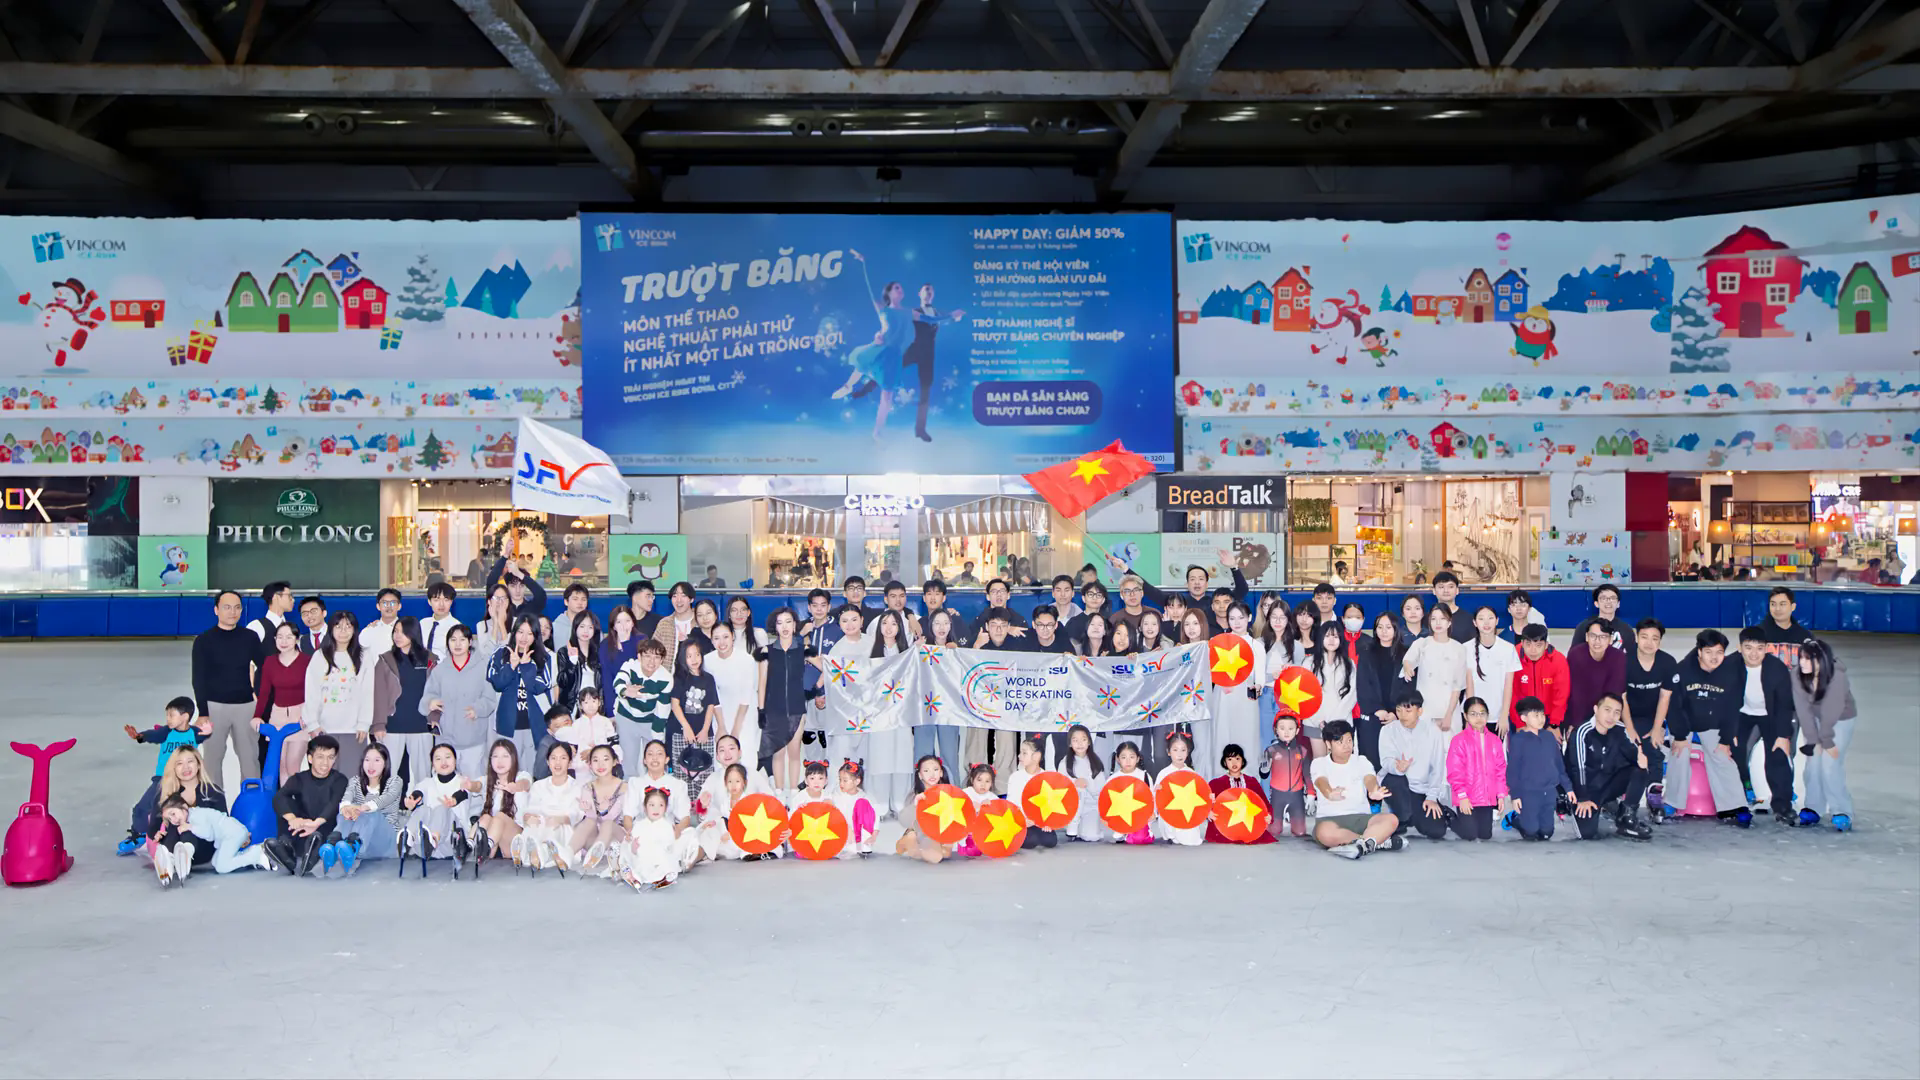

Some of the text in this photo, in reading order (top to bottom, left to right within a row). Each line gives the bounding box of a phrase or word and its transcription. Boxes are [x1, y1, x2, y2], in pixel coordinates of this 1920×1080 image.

[628, 229, 676, 240] VINCOM
[974, 224, 1125, 240] HAPPY DAY: GIẢM 50%
[66, 239, 126, 251] VINCOM
[1215, 240, 1271, 254] VINCOM
[974, 260, 1003, 271] ĐĂNG
[1044, 259, 1063, 273] HỘI
[1065, 260, 1089, 270] VIÊN
[621, 246, 843, 303] TRƯỢT BĂNG
[974, 273, 994, 286] TẬN
[1070, 273, 1086, 284] ƯU
[623, 315, 660, 334] MÔN
[697, 305, 739, 324] THAO
[623, 333, 666, 353] NGHỆ
[722, 321, 757, 341] PHẢI
[761, 314, 795, 333] THỬ
[972, 331, 1008, 344] TRƯỢT
[1010, 331, 1040, 341] BĂNG
[1042, 331, 1084, 341] CHUYÊN
[623, 357, 638, 373] ÍT
[641, 351, 682, 372] NHẤT
[685, 344, 720, 367] MỘT
[623, 392, 656, 403] VINCOM
[657, 390, 671, 399] ICE
[717, 381, 737, 391] CITY
[986, 391, 1011, 405] BẠN
[1013, 390, 1028, 402] ĐÃ
[1057, 389, 1090, 402] SÀNG
[986, 405, 1090, 418] TRƯỢT BĂNG CHƯA?
[1150, 454, 1165, 462] 320)
[1168, 485, 1273, 505] BreadTalk
[0, 488, 51, 522] OX
[276, 505, 319, 513] PHUC LONG
[216, 524, 374, 543] PHUC LONG
[1005, 676, 1047, 687] WORLD
[1005, 689, 1072, 699] ICE SKATING
[1005, 701, 1027, 711] DAY
